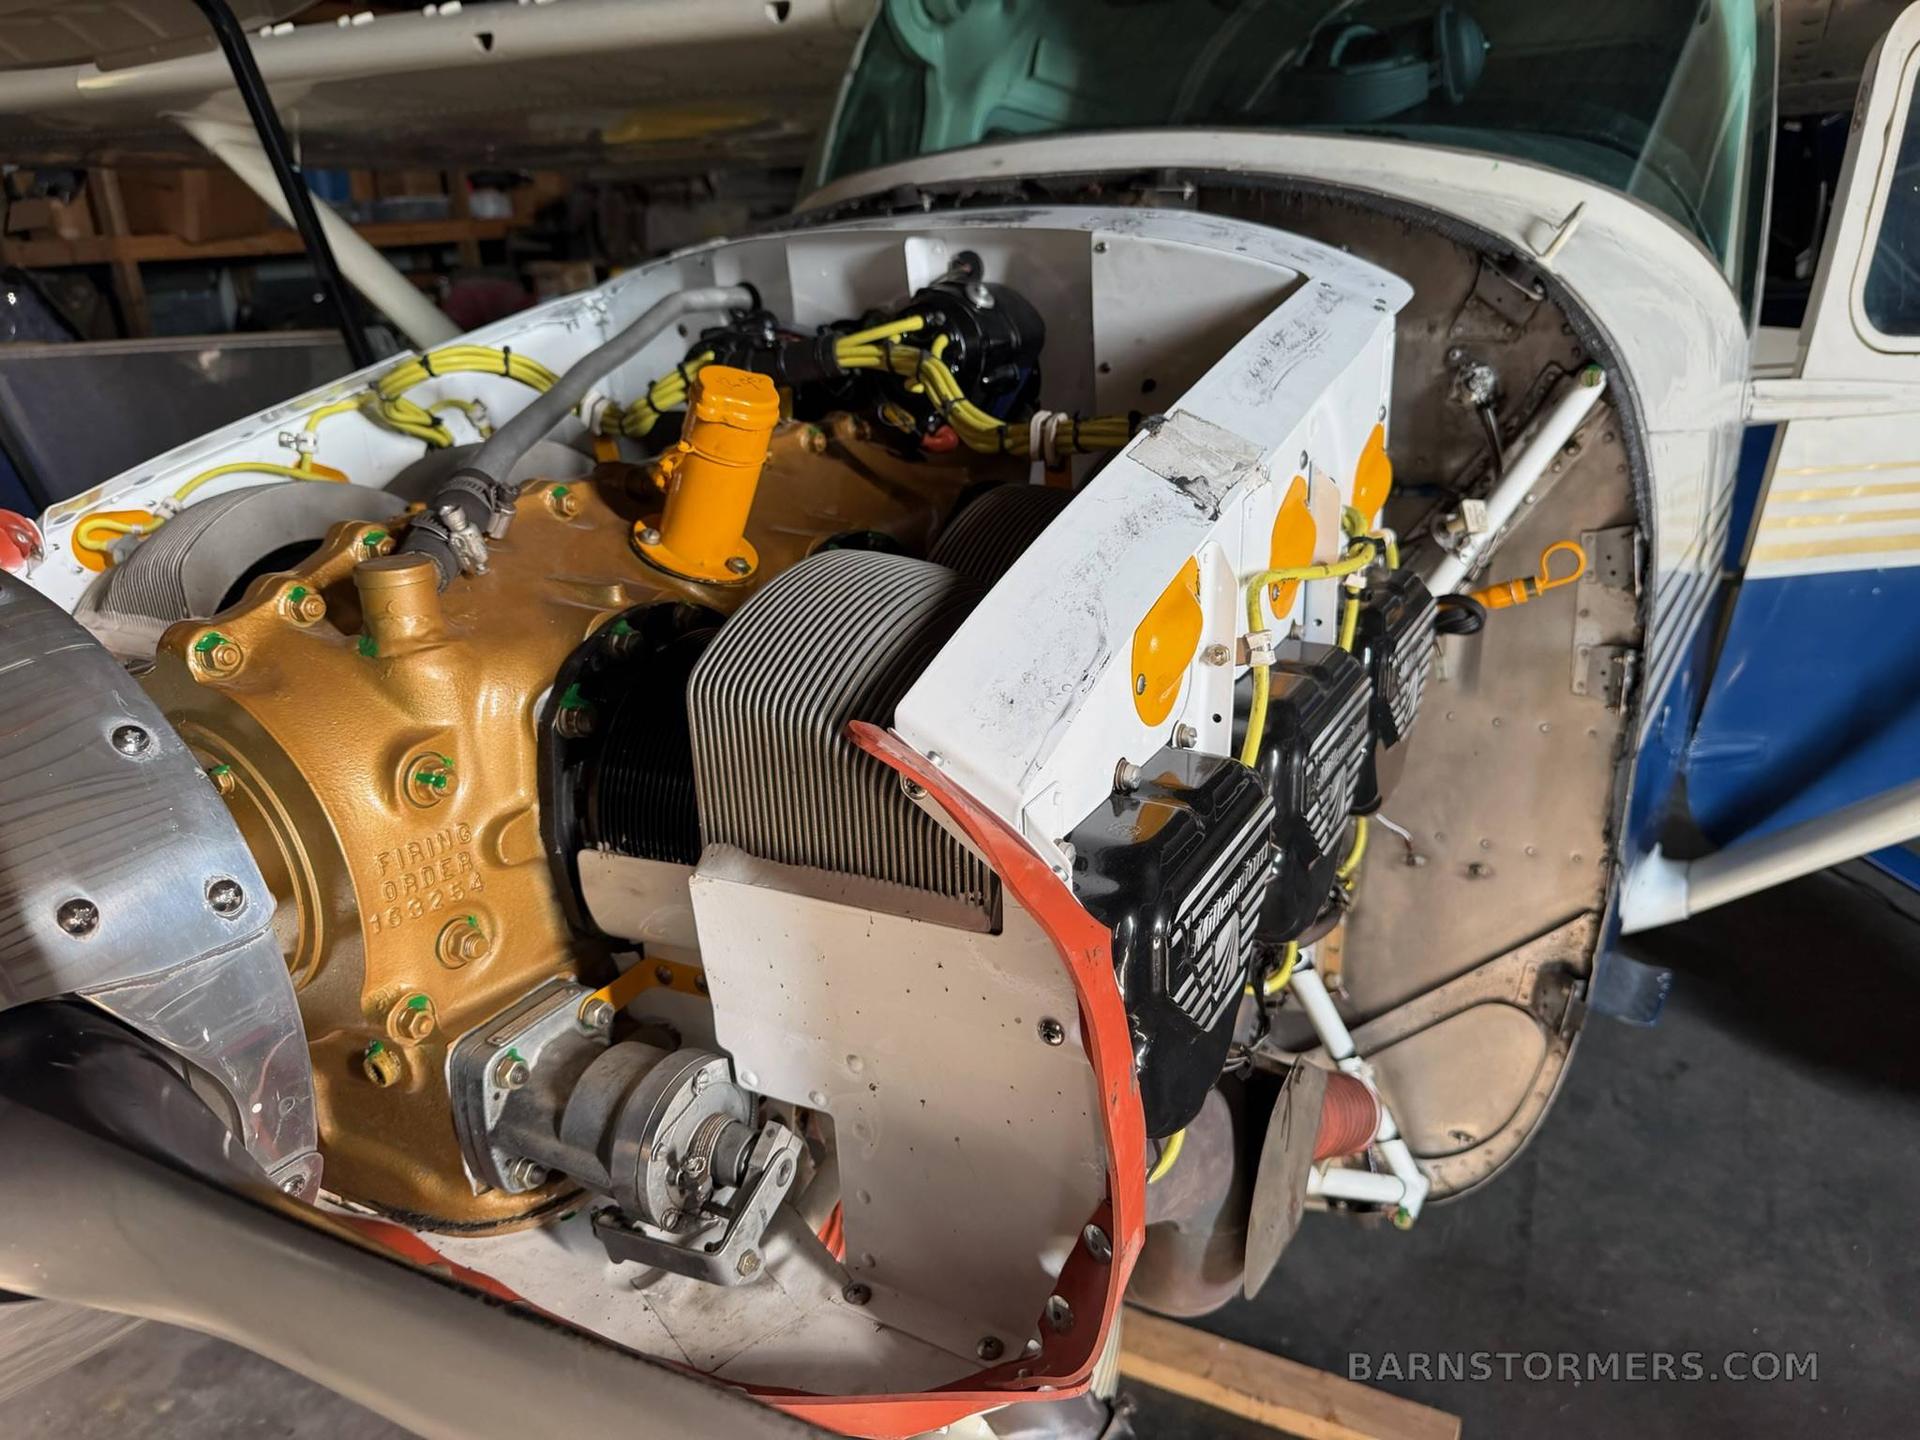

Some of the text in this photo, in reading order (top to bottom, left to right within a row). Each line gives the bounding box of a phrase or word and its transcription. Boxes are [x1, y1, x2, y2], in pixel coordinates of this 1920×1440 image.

[375, 823, 472, 876] FIRING
[383, 851, 473, 902] ORDER
[370, 872, 483, 934] 163254
[1190, 841, 1269, 958] Millennium
